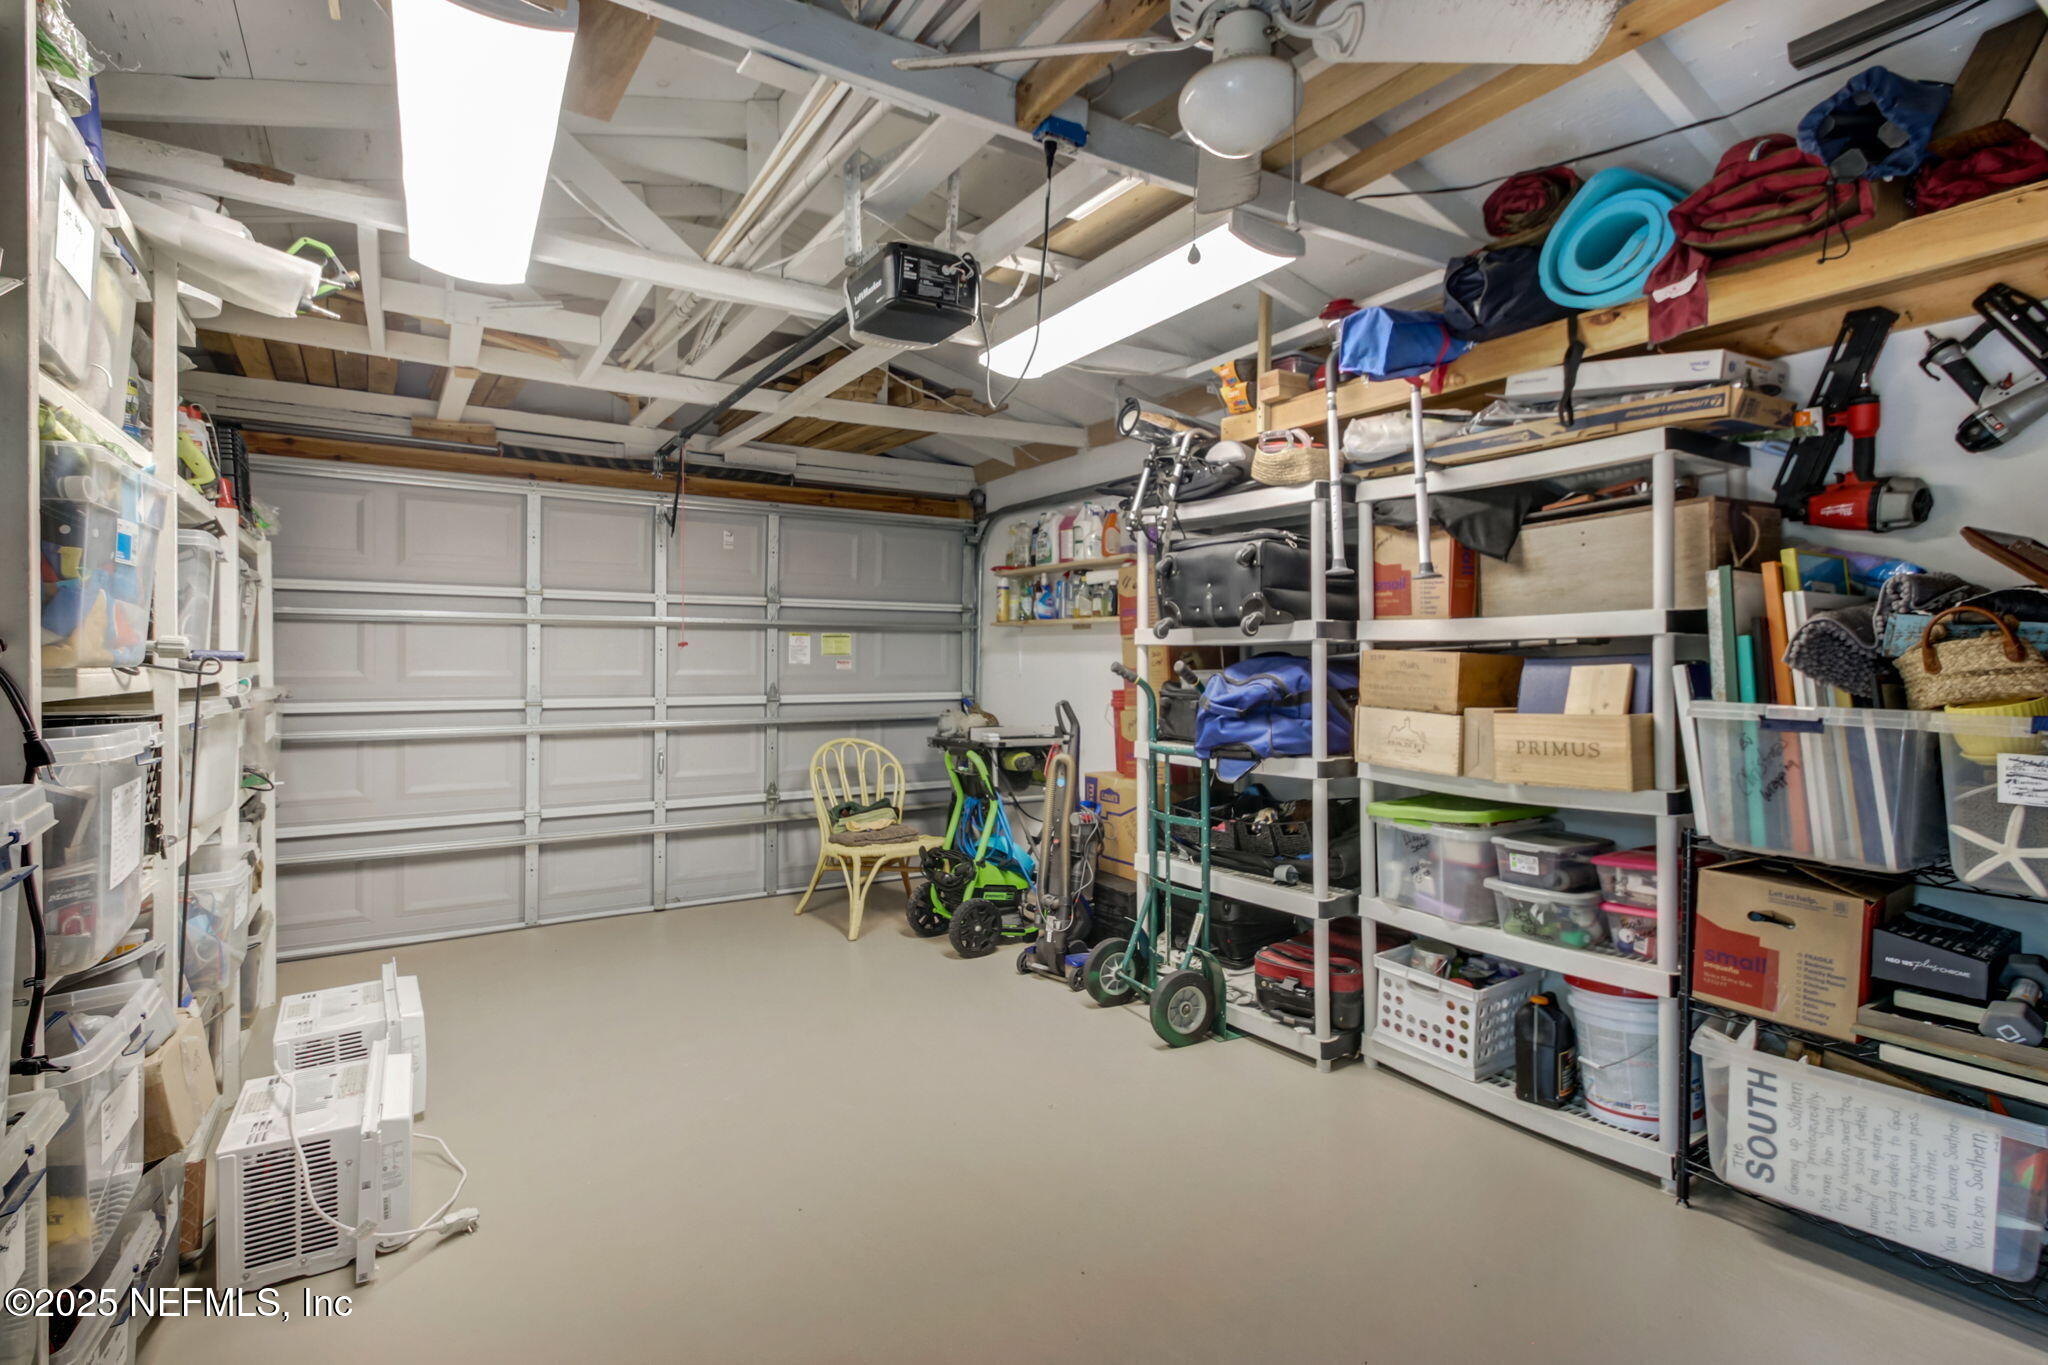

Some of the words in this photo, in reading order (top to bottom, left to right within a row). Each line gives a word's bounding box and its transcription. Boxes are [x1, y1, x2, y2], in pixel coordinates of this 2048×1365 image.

[1516, 739, 1601, 758] PRIMUS
[1703, 949, 1766, 974] small
[1786, 1082, 1804, 1131] Southern
[1745, 1067, 1778, 1183] SOUTH
[1789, 1137, 1802, 1152] up
